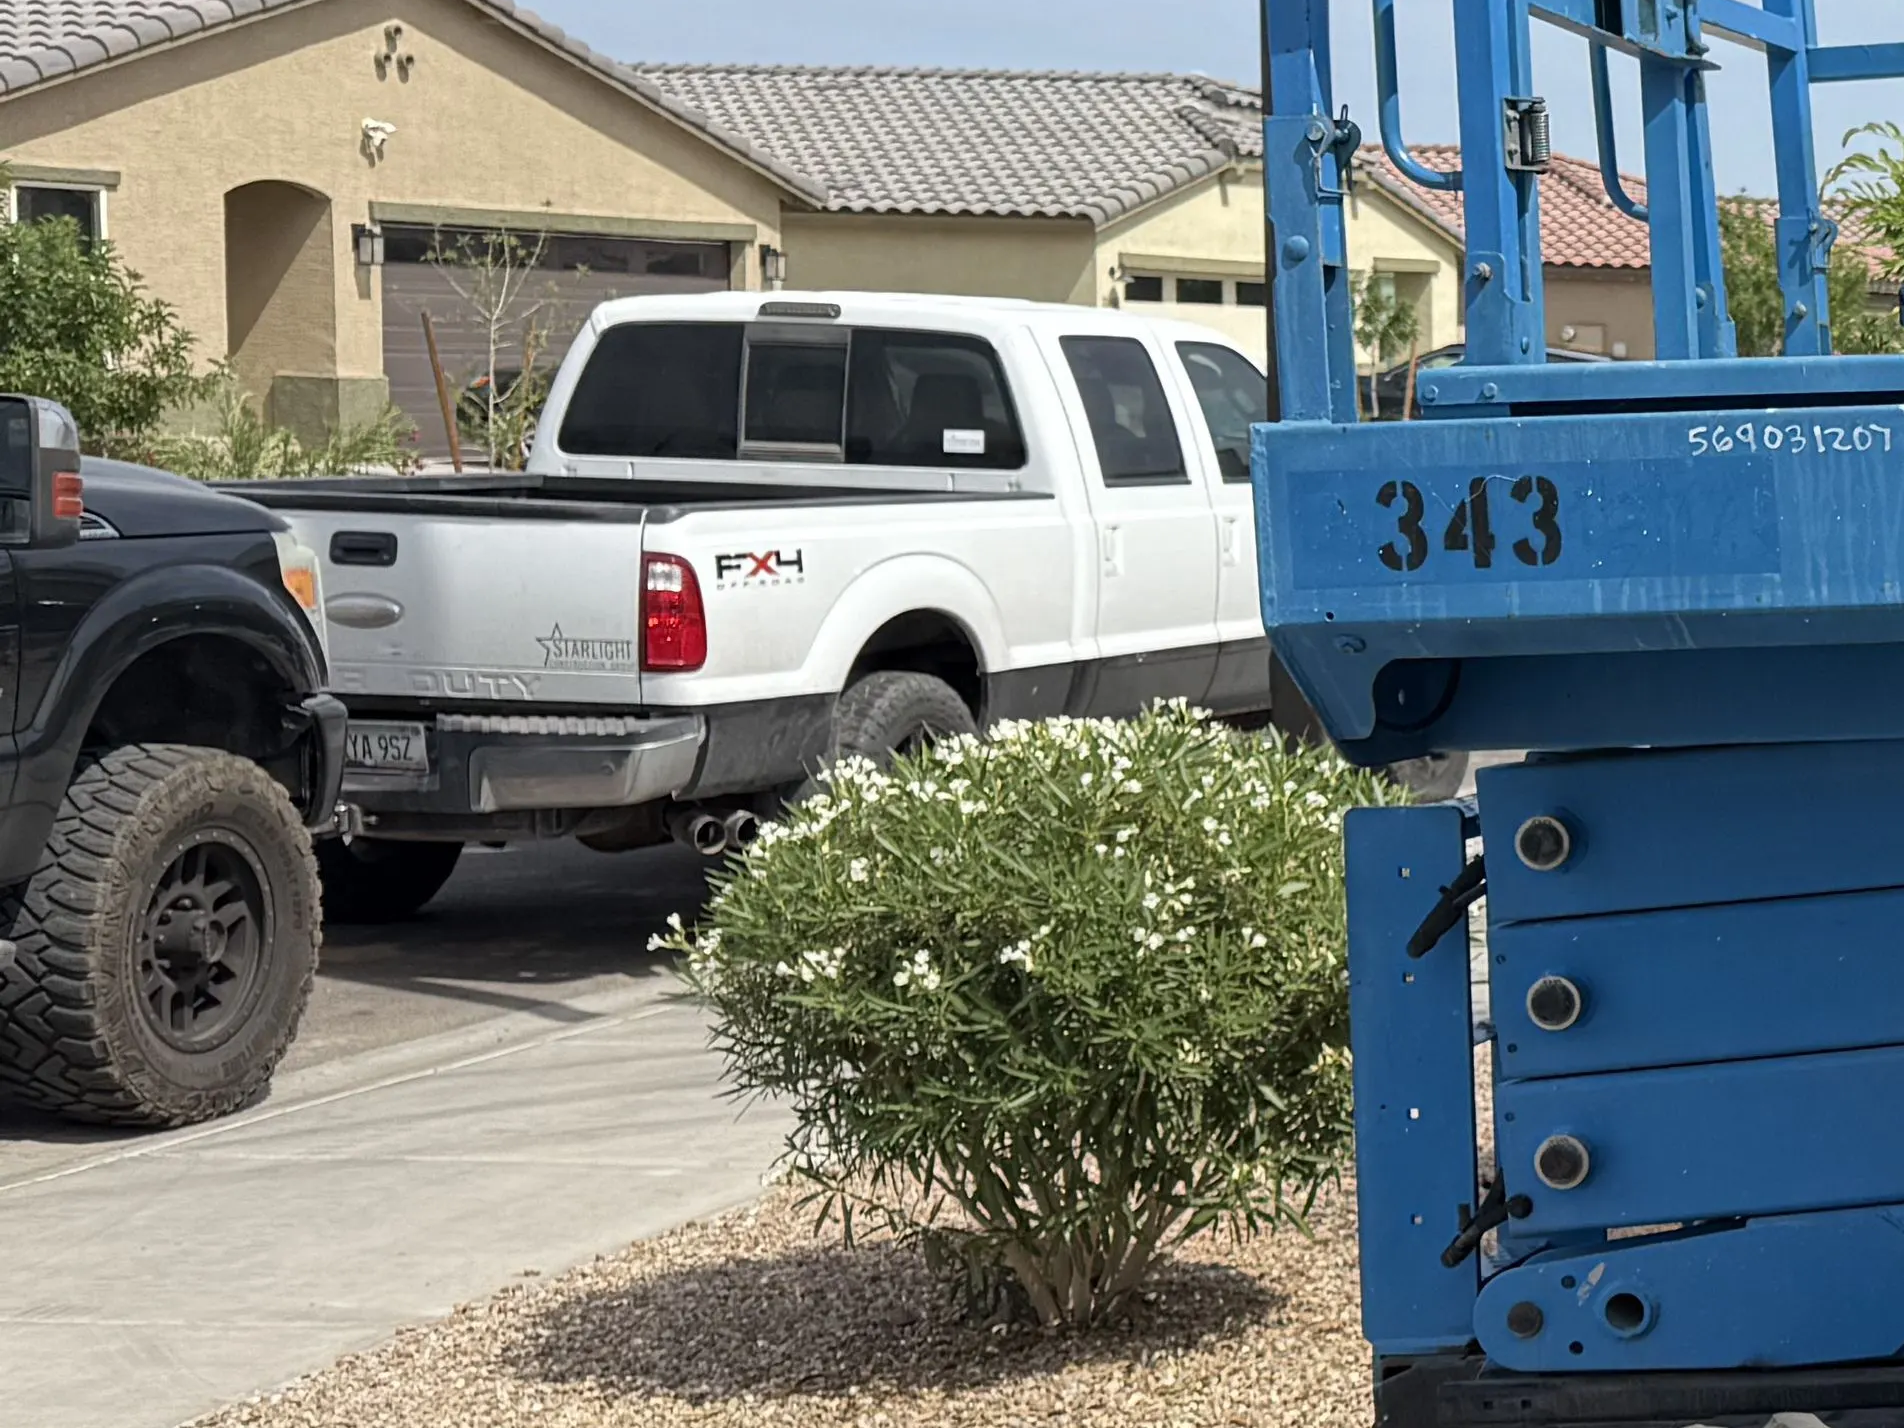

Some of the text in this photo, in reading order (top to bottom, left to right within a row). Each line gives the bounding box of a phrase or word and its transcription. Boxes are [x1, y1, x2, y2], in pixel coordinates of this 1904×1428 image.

[1688, 422, 1892, 456] 569031207
[1375, 474, 1562, 572] 343
[715, 548, 804, 580] FX4
[553, 638, 632, 661] STARLIGHT
[411, 672, 542, 701] DUTY
[346, 734, 373, 763] YA
